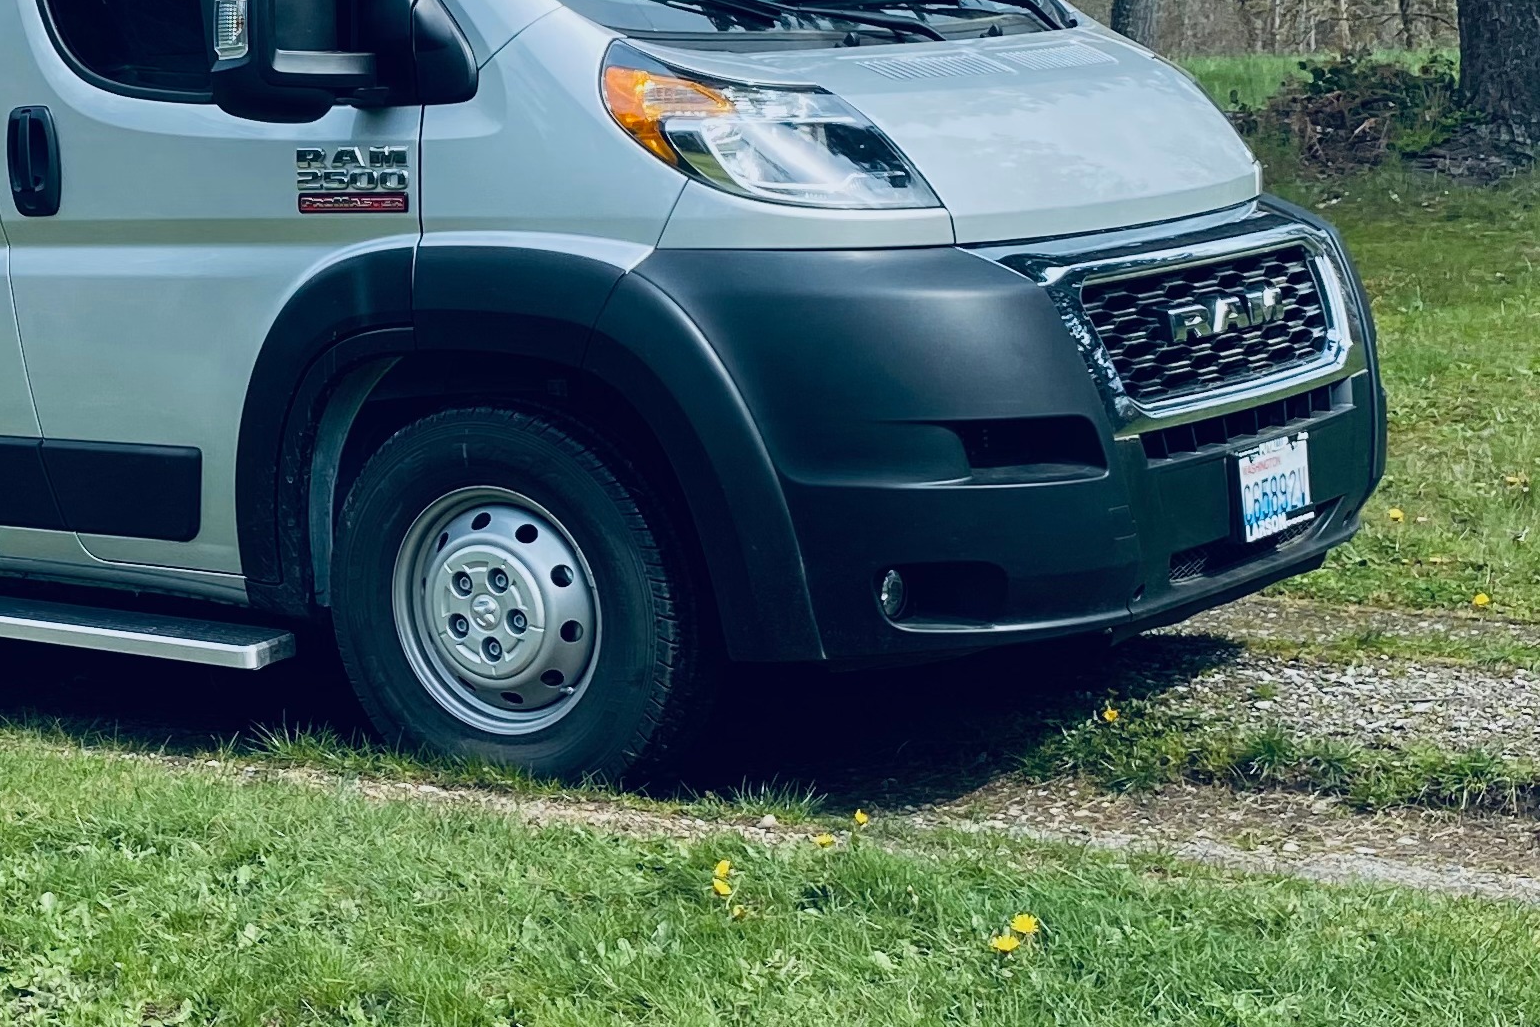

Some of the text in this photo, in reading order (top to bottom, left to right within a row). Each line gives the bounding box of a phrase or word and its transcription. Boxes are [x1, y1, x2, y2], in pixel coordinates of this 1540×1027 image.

[296, 146, 409, 168] RAM
[297, 169, 409, 190] 2500
[1168, 285, 1284, 342] RAM
[1242, 456, 1281, 475] WASHINGTON
[1246, 513, 1287, 542] LARSON
